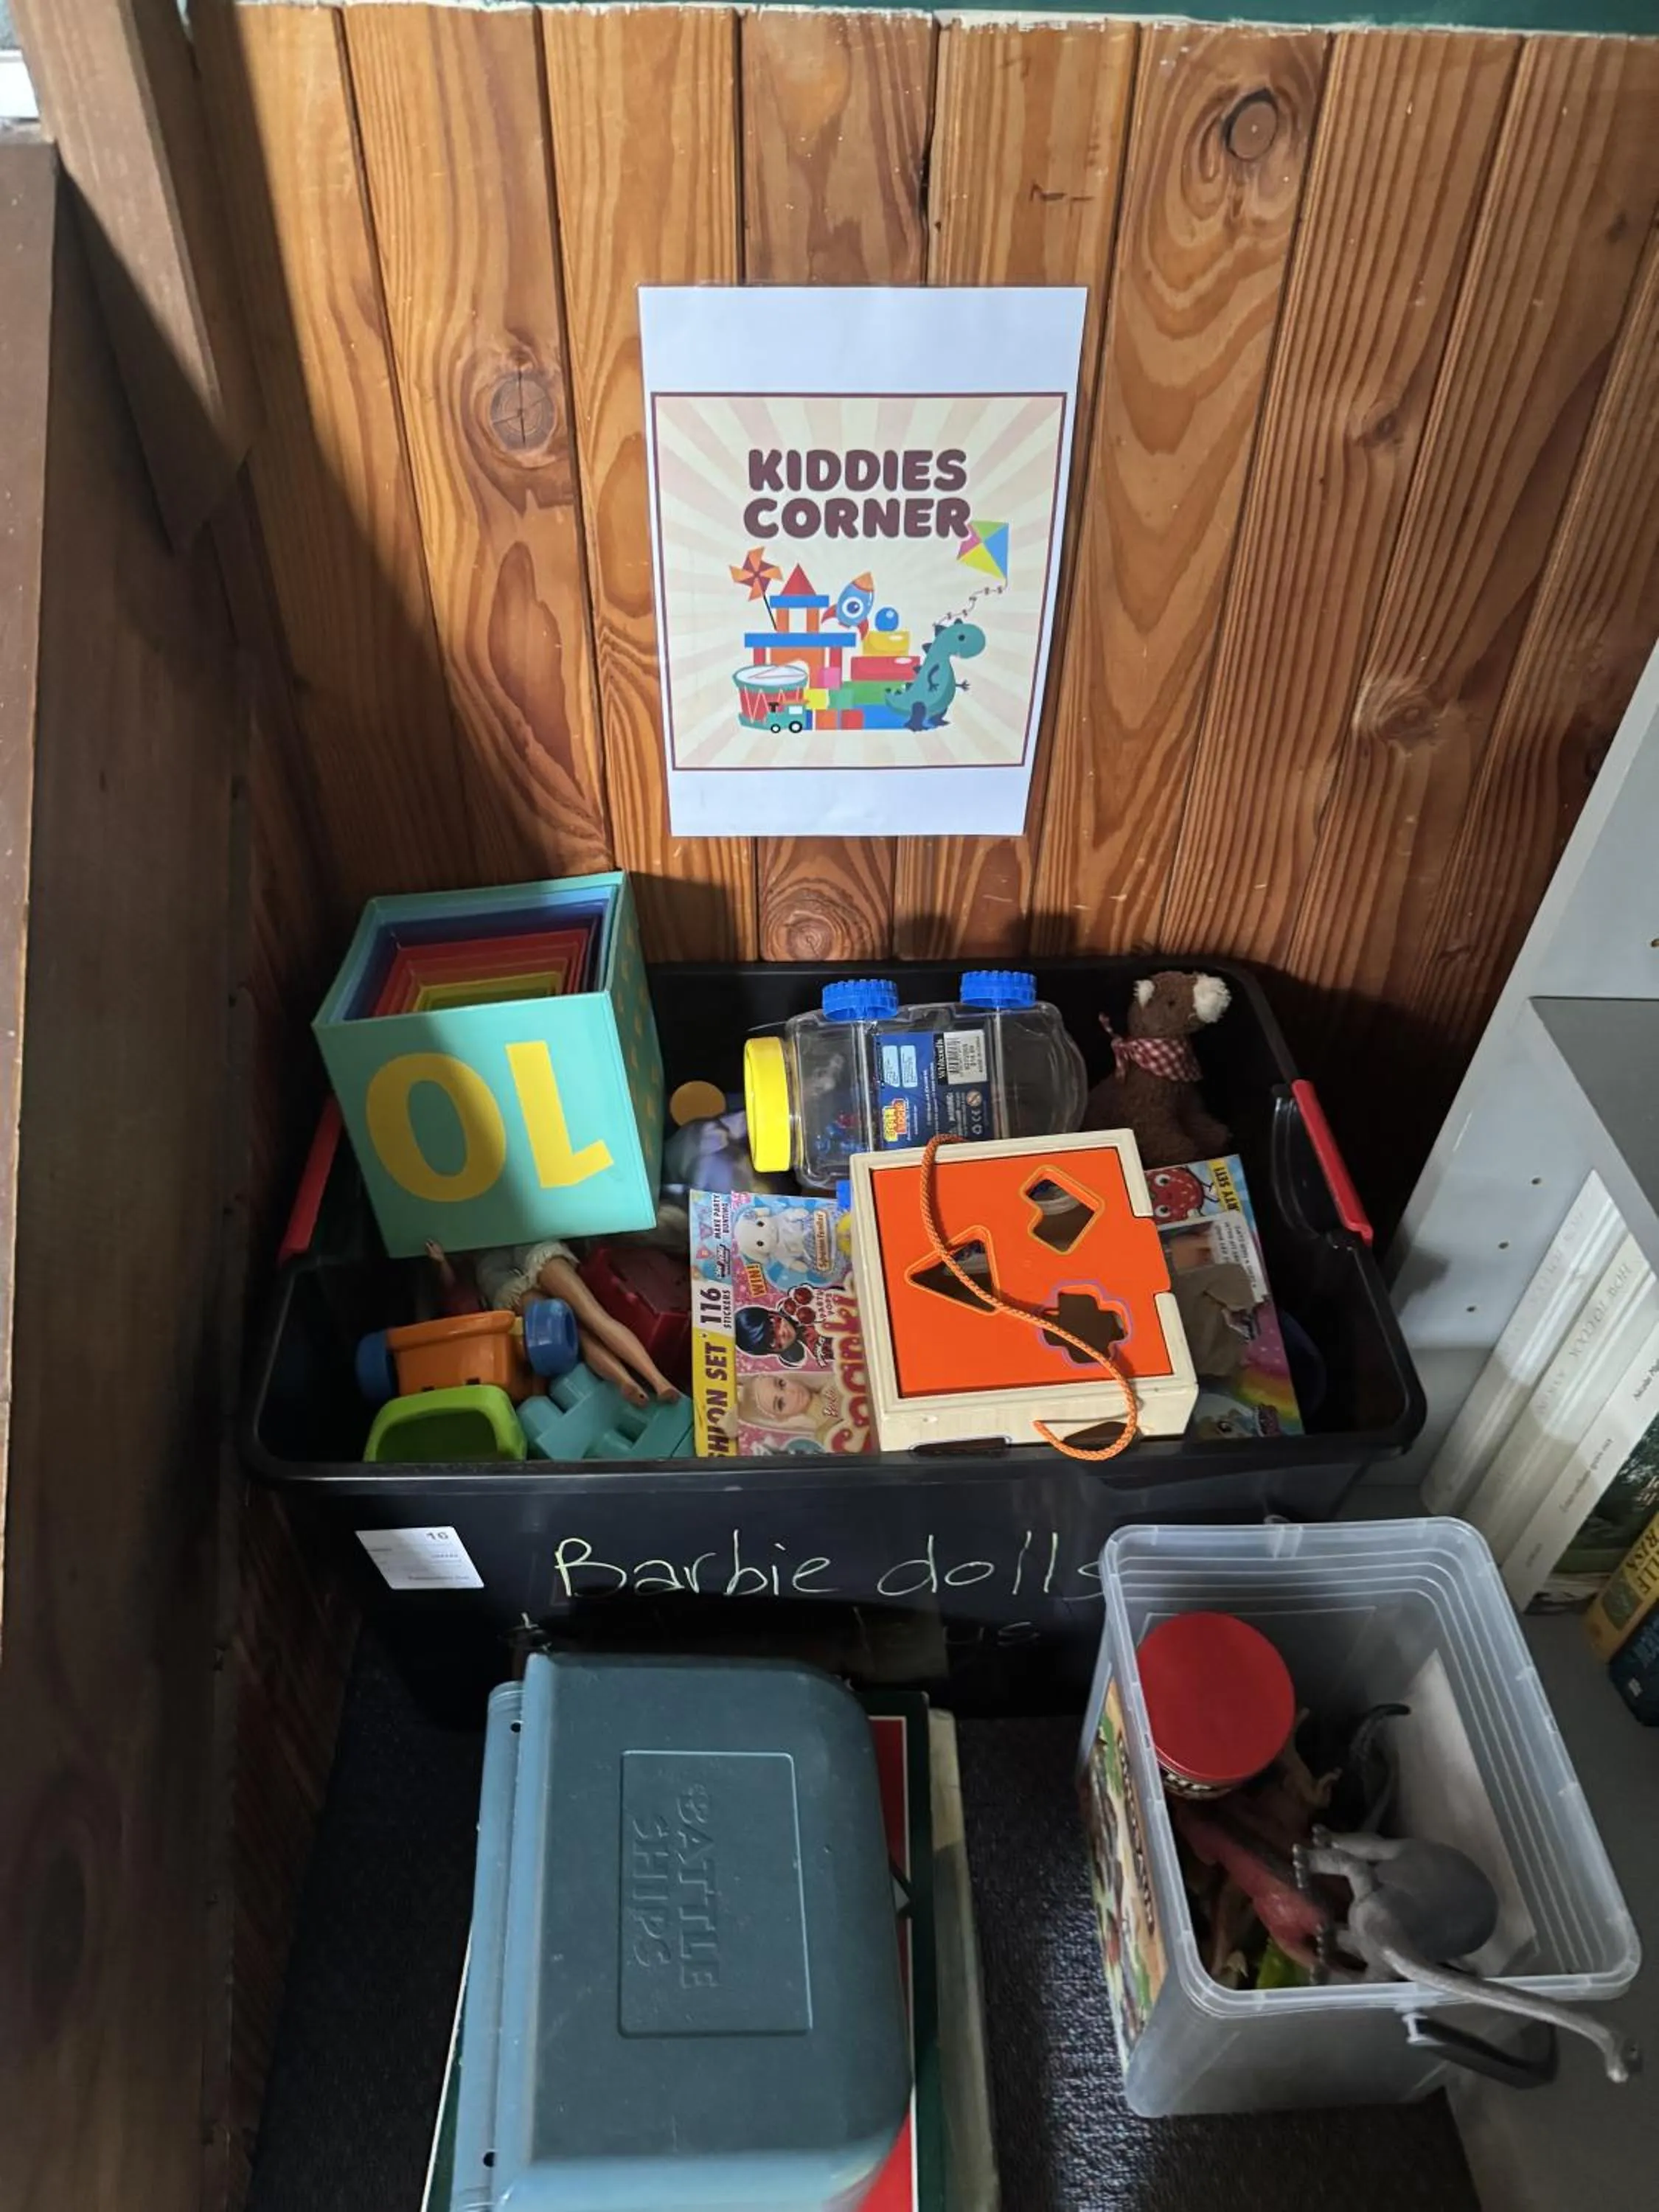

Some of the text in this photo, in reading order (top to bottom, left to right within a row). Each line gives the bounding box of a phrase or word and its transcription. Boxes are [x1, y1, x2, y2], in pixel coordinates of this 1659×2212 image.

[747, 448, 968, 493] KIDDIES
[742, 497, 972, 539] CORNER
[366, 1040, 614, 1202] 10
[747, 1265, 765, 1295] WIN!
[700, 1288, 722, 1324] 116
[723, 1290, 732, 1329] STICKERS
[705, 1342, 728, 1381] SET
[554, 1528, 841, 1598] Barbie
[632, 1816, 671, 1967] SHIPS
[677, 1784, 719, 1989] BATTLE
